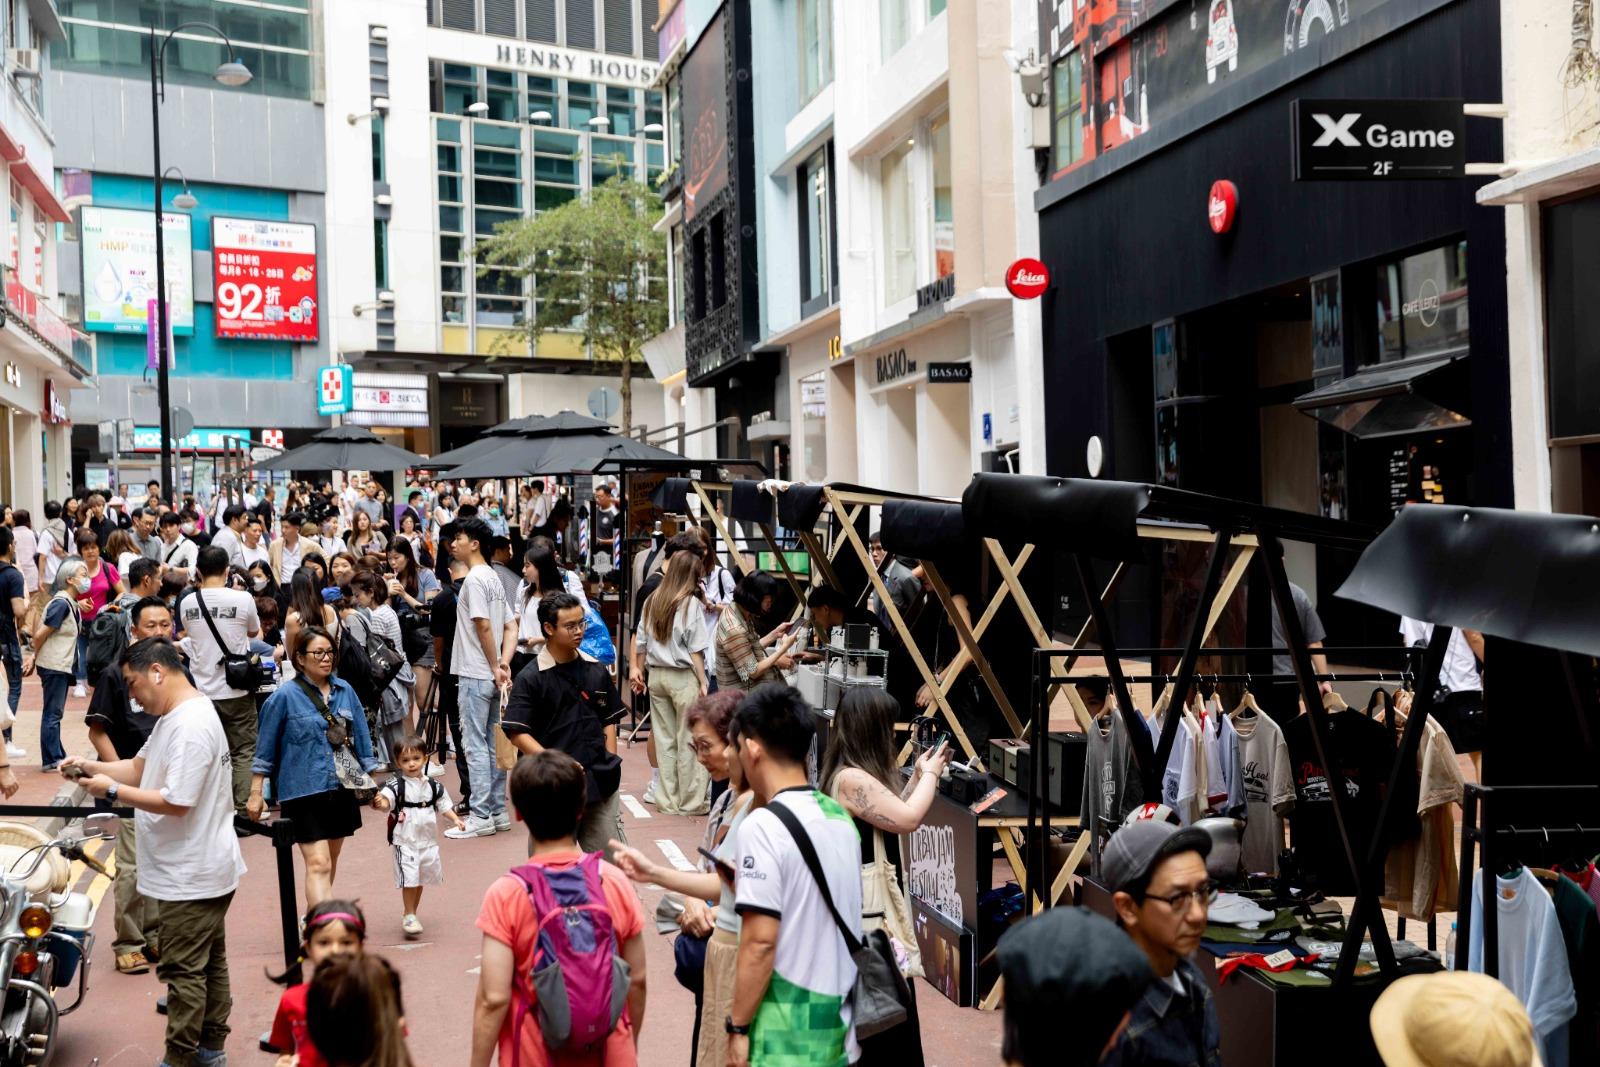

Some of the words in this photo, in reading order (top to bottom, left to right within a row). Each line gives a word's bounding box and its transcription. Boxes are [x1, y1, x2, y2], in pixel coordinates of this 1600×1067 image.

[496, 44, 576, 72] HENRY
[1311, 113, 1362, 147] X
[1366, 124, 1455, 148] Game
[1373, 161, 1393, 176] 2F
[1012, 269, 1046, 286] Leica
[218, 281, 264, 321] 92
[265, 285, 282, 306] 折
[876, 348, 907, 384] BASAO
[931, 367, 969, 377] BASAO
[911, 830, 936, 863] URBAN
[937, 830, 954, 868] JAM
